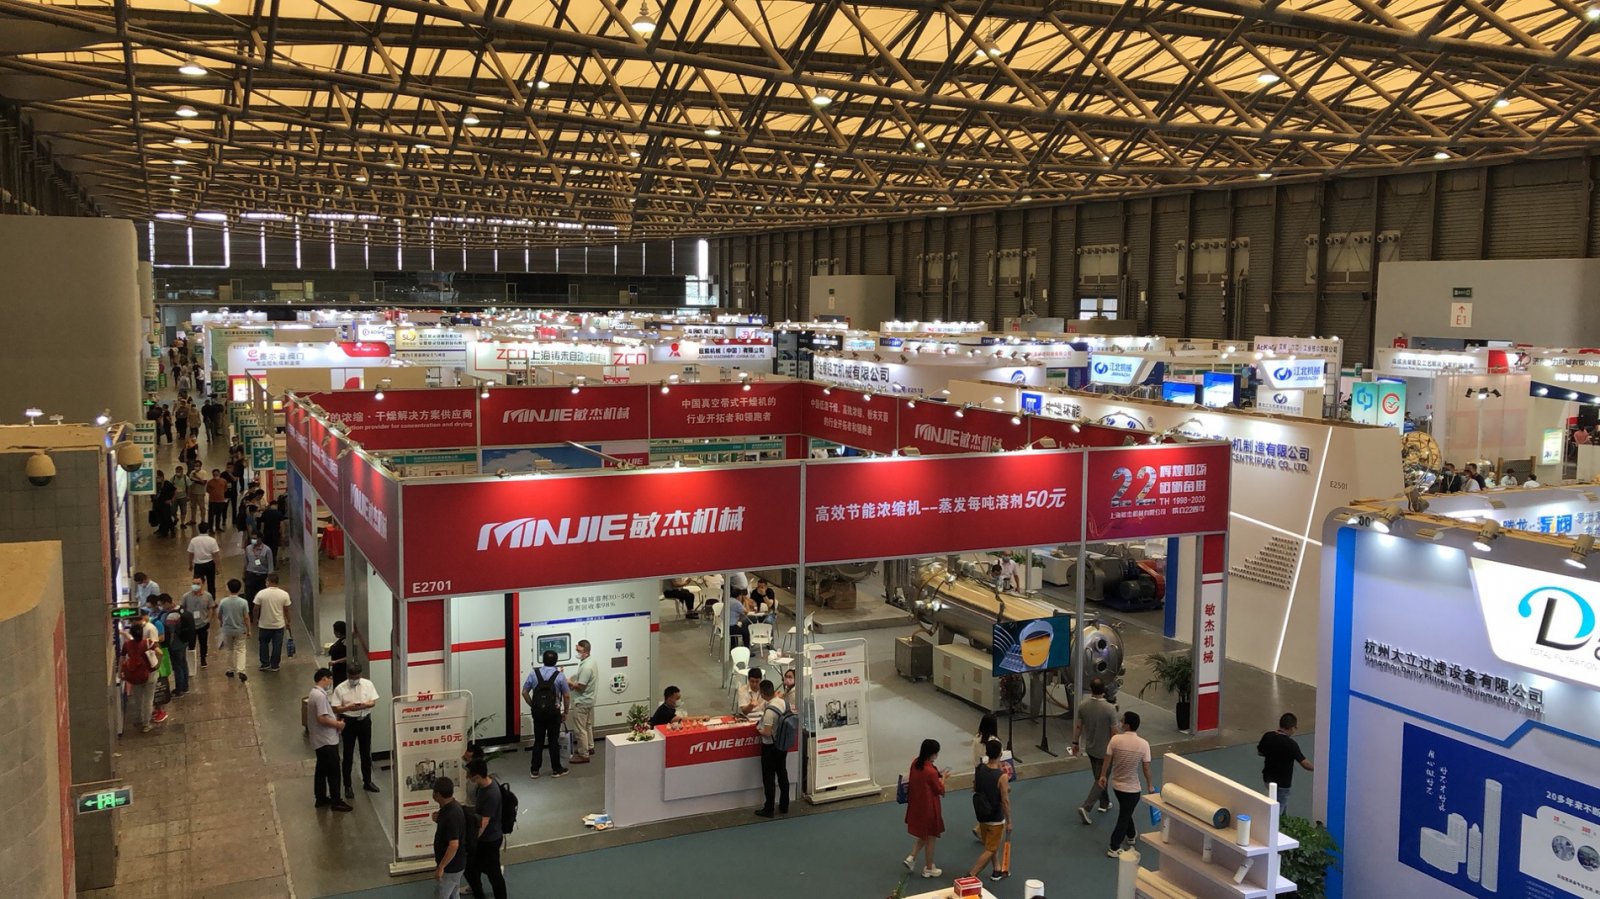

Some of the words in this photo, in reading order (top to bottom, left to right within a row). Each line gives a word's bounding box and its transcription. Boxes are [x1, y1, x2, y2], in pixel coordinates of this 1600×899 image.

[1293, 366, 1321, 377] 江北机械
[681, 396, 777, 409] 中国真空带式干燥机的
[503, 408, 573, 423] MINJIE
[574, 406, 630, 422] 敏杰机械
[1232, 437, 1310, 461] 机制造有限公司
[1111, 465, 1157, 508] 22
[1159, 497, 1170, 506] TH
[477, 513, 629, 551] MINJIE
[629, 505, 746, 540] 敏杰机械
[412, 580, 452, 594] E2701
[1202, 603, 1217, 664] 敏杰机械
[1364, 638, 1544, 706] 杭州大立过滤设备有限公司
